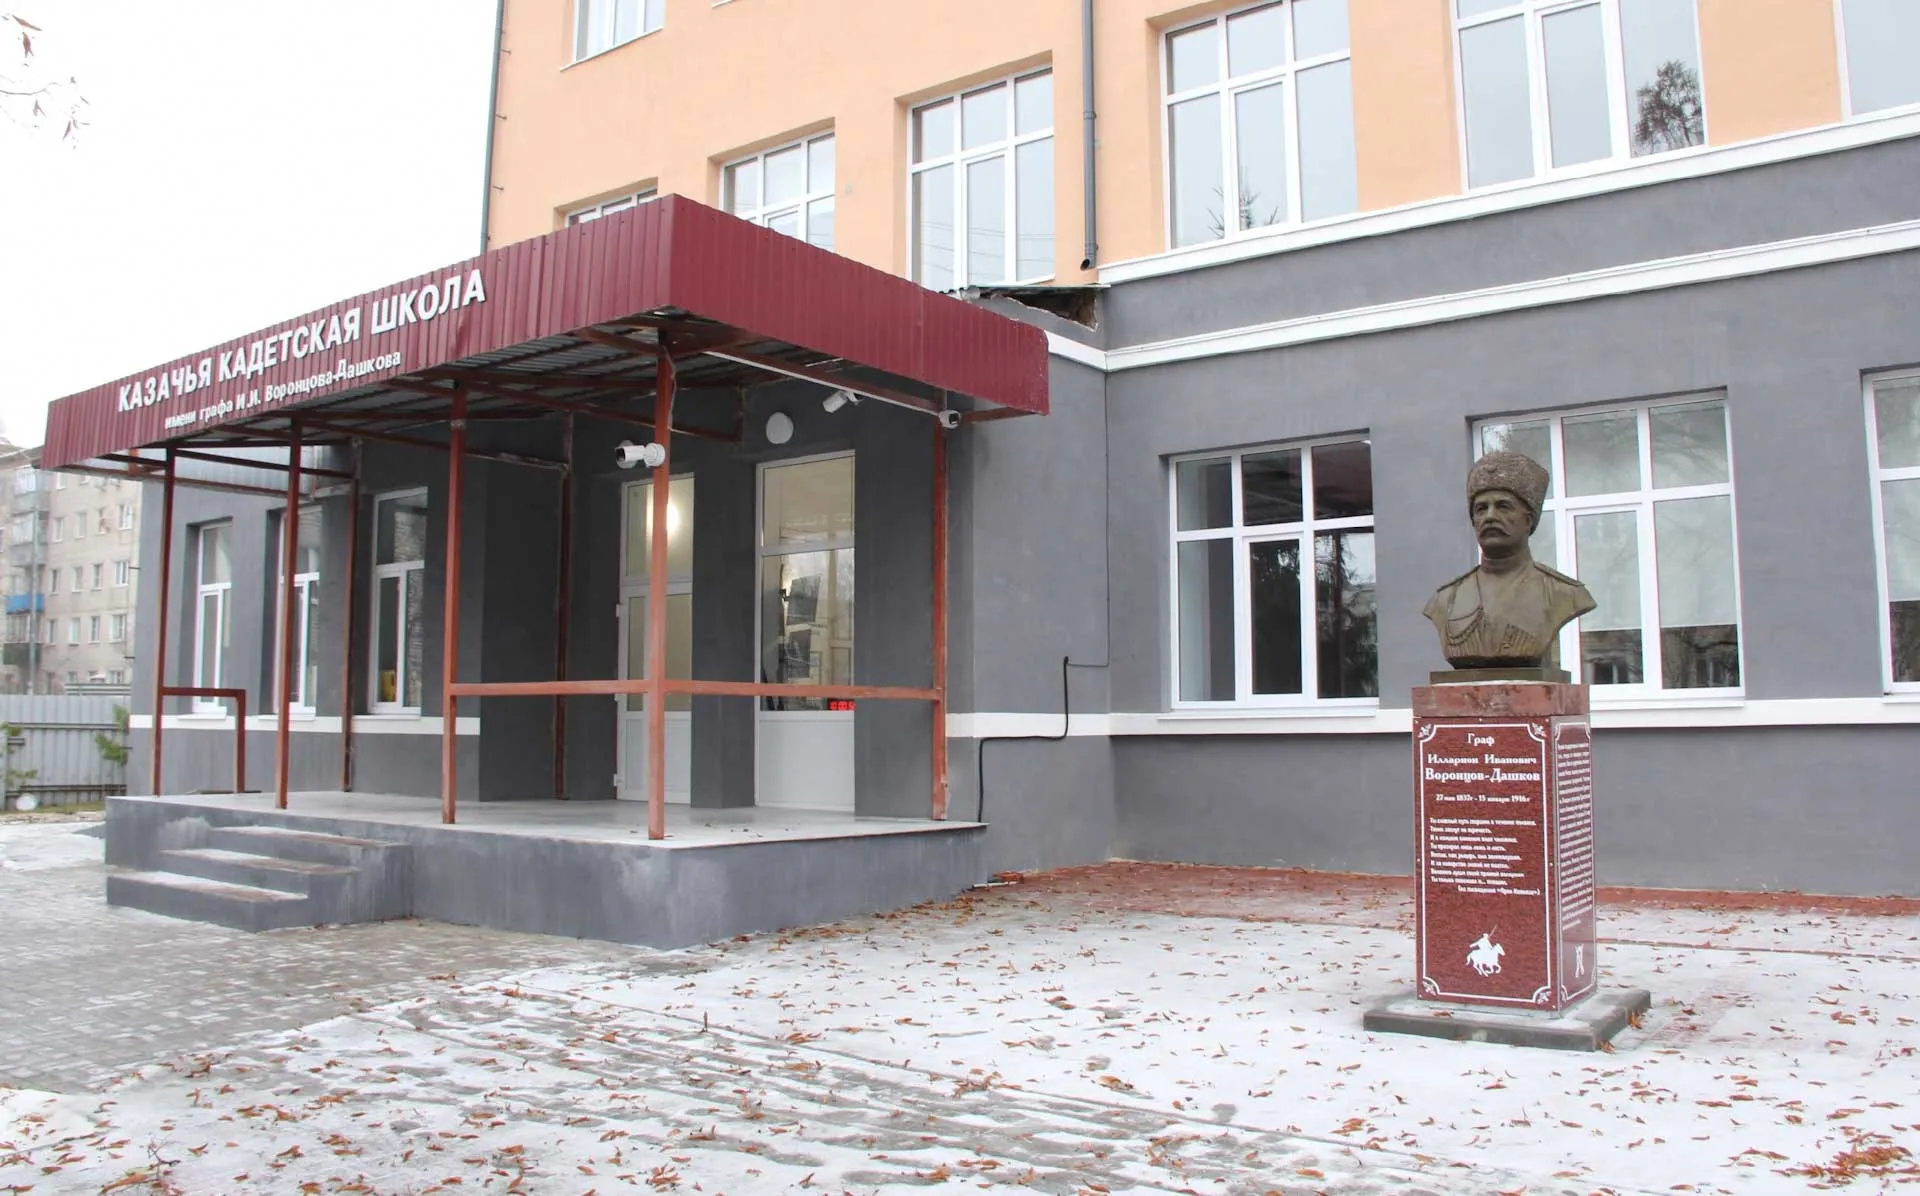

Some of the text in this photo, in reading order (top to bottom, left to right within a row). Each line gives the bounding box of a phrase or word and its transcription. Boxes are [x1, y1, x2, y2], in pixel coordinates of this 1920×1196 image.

[118, 268, 486, 412] КАЗАЧЬЯ КАДЕТСКАЯ ШКОЛА
[164, 351, 401, 429] имени графа И.И. Воронцова-Дашкова
[1467, 733, 1495, 746] Граф
[1427, 754, 1537, 766] Илларион Иванович
[1425, 768, 1540, 783] Воронцов-Дашков
